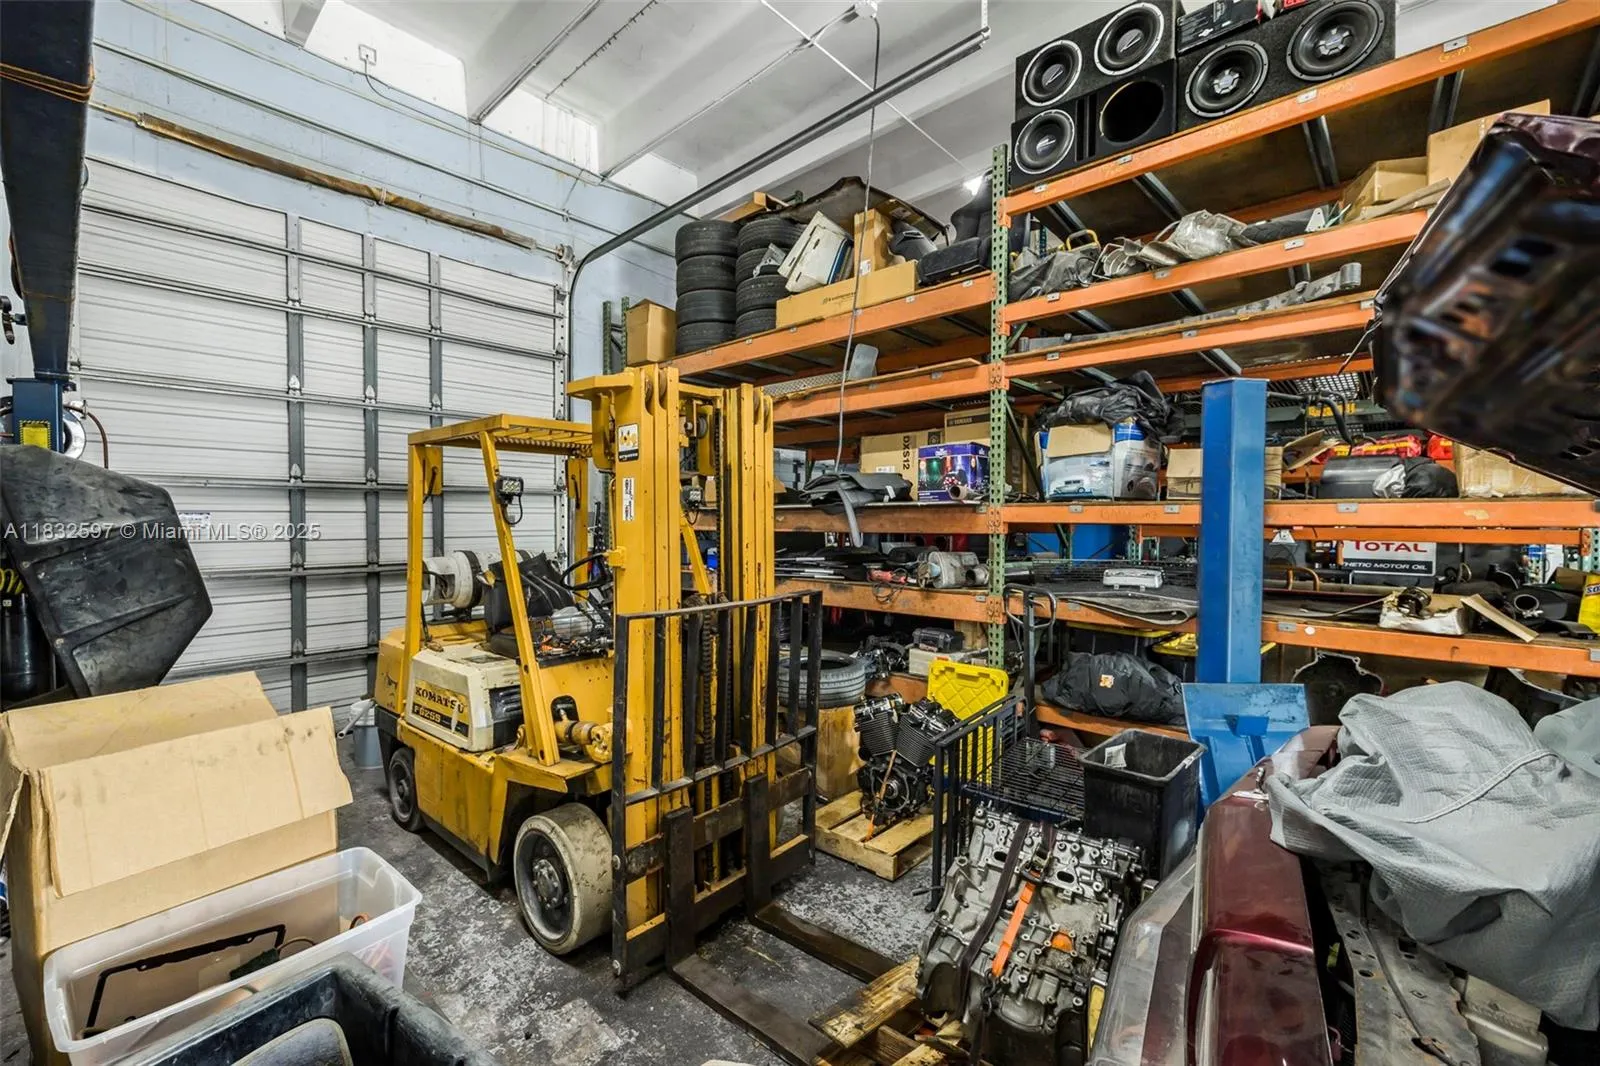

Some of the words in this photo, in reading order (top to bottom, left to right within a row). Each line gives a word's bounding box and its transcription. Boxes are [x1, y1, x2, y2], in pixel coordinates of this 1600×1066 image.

[902, 435, 911, 471] DXS12
[1353, 540, 1428, 553] TOTAL
[415, 686, 465, 714] KOMATSU
